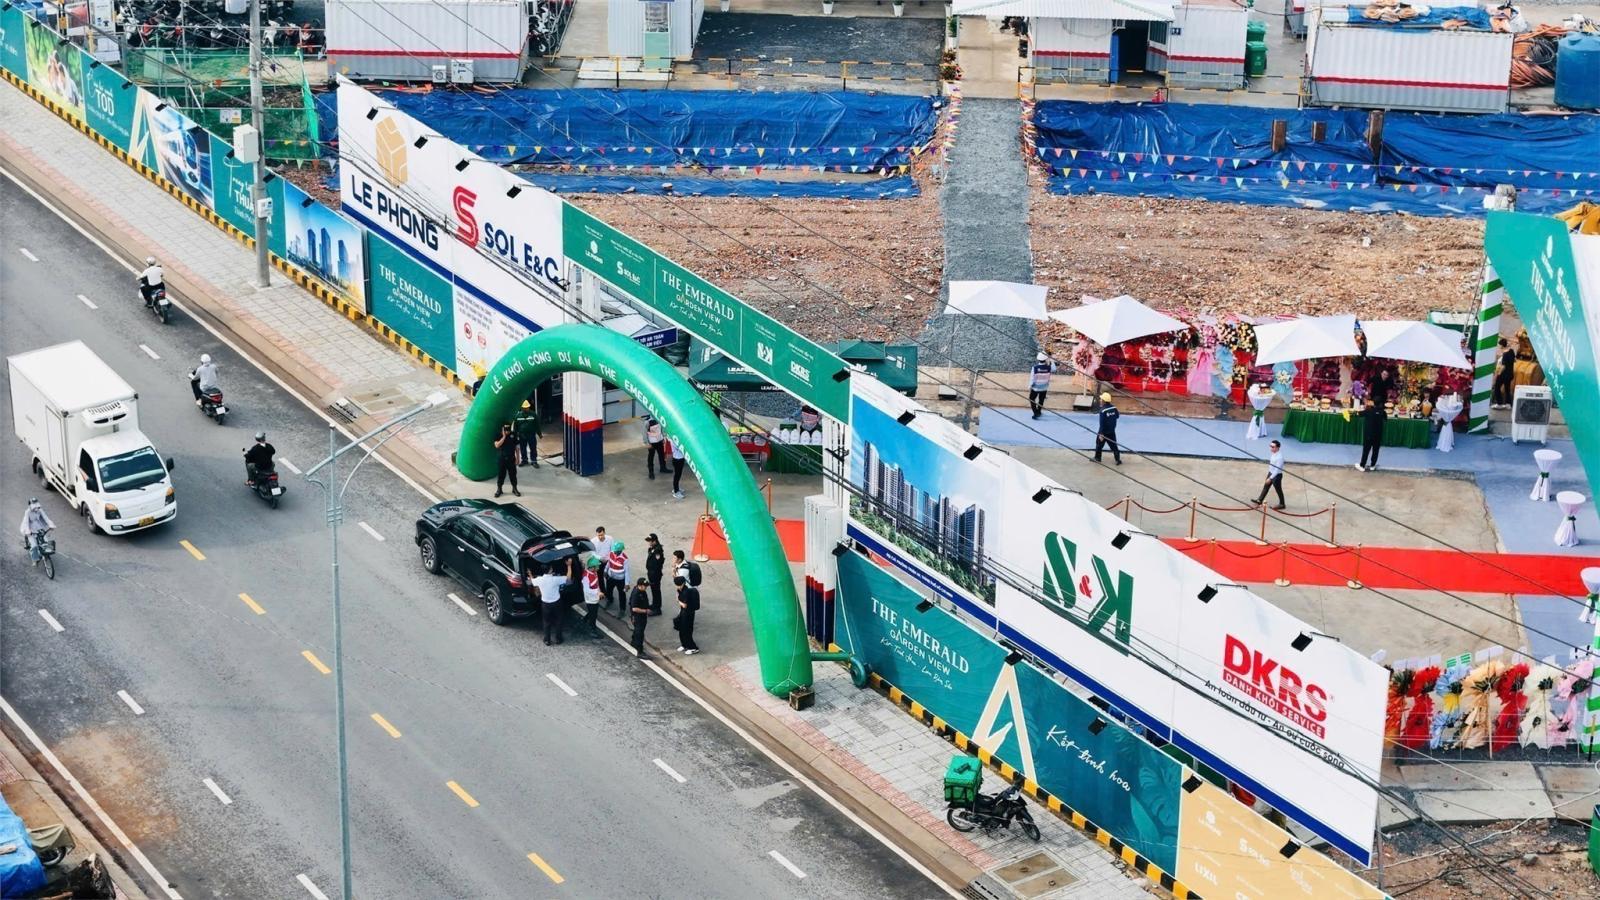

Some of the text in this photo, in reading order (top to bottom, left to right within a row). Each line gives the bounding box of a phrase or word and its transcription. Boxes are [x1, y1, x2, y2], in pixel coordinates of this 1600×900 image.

[96, 89, 114, 117] TOD
[351, 174, 438, 252] LE PHONG
[484, 222, 518, 264] SOL
[524, 244, 558, 284] E&C
[379, 264, 397, 285] THE
[399, 277, 442, 314] EMERALD
[392, 288, 415, 307] GARDEN
[416, 304, 431, 318] VIEW
[662, 270, 682, 292] THE
[685, 283, 734, 320] EMERALD
[676, 293, 703, 313] GARDEN
[704, 310, 721, 325] VIEW
[1530, 260, 1544, 304] THE
[1544, 289, 1576, 371] EMERALD
[527, 350, 552, 366] CÔNG
[578, 352, 592, 368] ÁN
[598, 364, 617, 382] THE
[624, 379, 666, 428] EMERALD
[672, 435, 708, 492] GARDEN
[1042, 530, 1134, 647] S&K
[870, 597, 969, 674] THE EMERALD
[890, 628, 951, 675] GARDEN VIEW
[1224, 634, 1328, 722] DKRS
[1226, 674, 1252, 696] DANH
[1282, 706, 1323, 738] SERVICE
[1273, 720, 1284, 731] An
[1046, 724, 1080, 751] Kết
[1109, 769, 1132, 792] hoa
